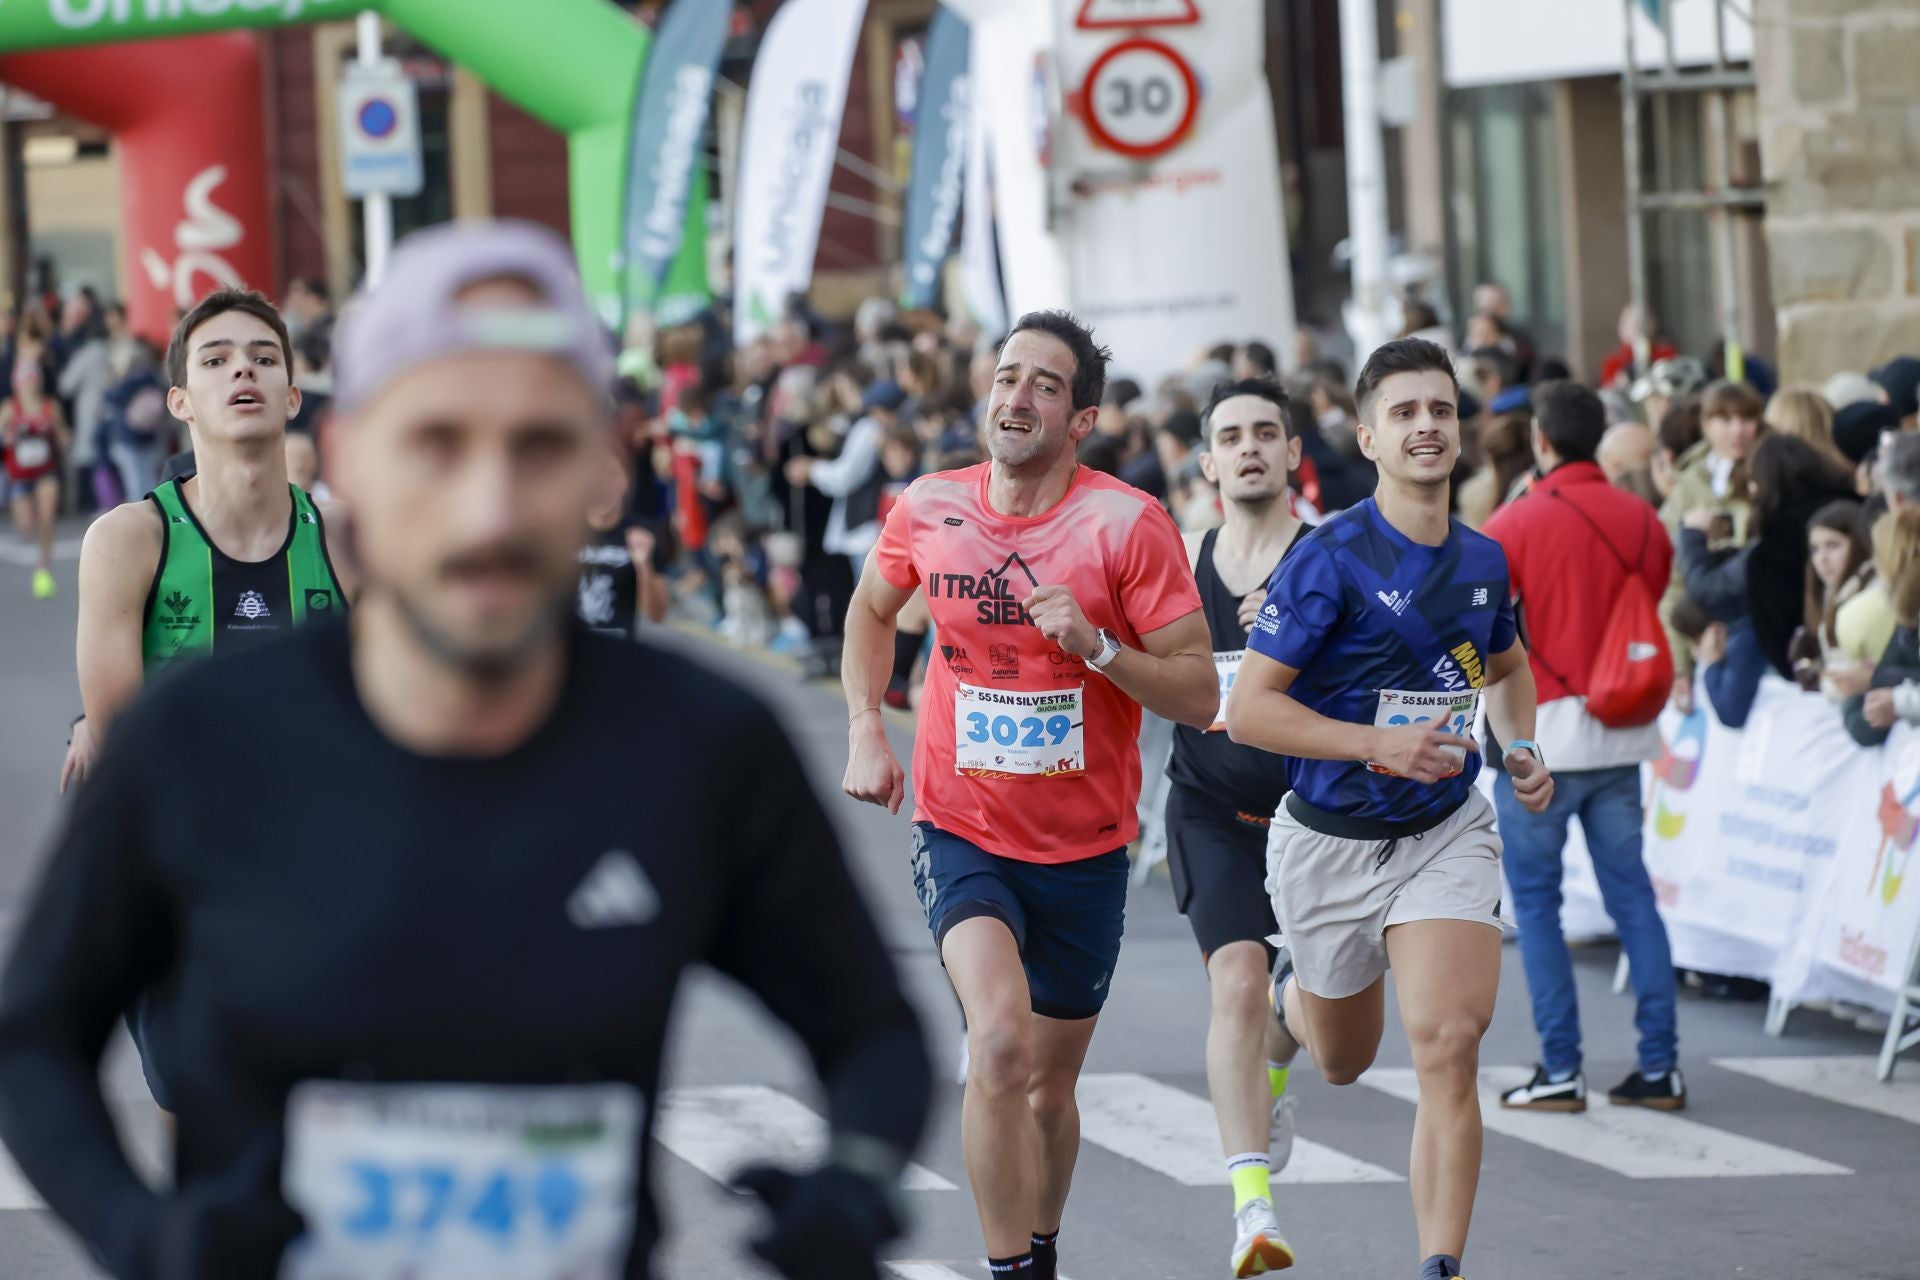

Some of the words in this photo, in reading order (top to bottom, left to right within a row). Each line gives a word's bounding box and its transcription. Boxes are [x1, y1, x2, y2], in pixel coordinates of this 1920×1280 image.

[1106, 77, 1172, 117] 30
[943, 574, 1015, 601] TRAIL
[978, 692, 992, 702] 55
[993, 694, 1015, 706] SAN
[1016, 693, 1076, 706] SILVESTRE
[1402, 696, 1415, 705] 55
[1416, 696, 1435, 706] SAN
[1436, 693, 1473, 706] SILVESTRE
[966, 711, 1071, 747] 3029
